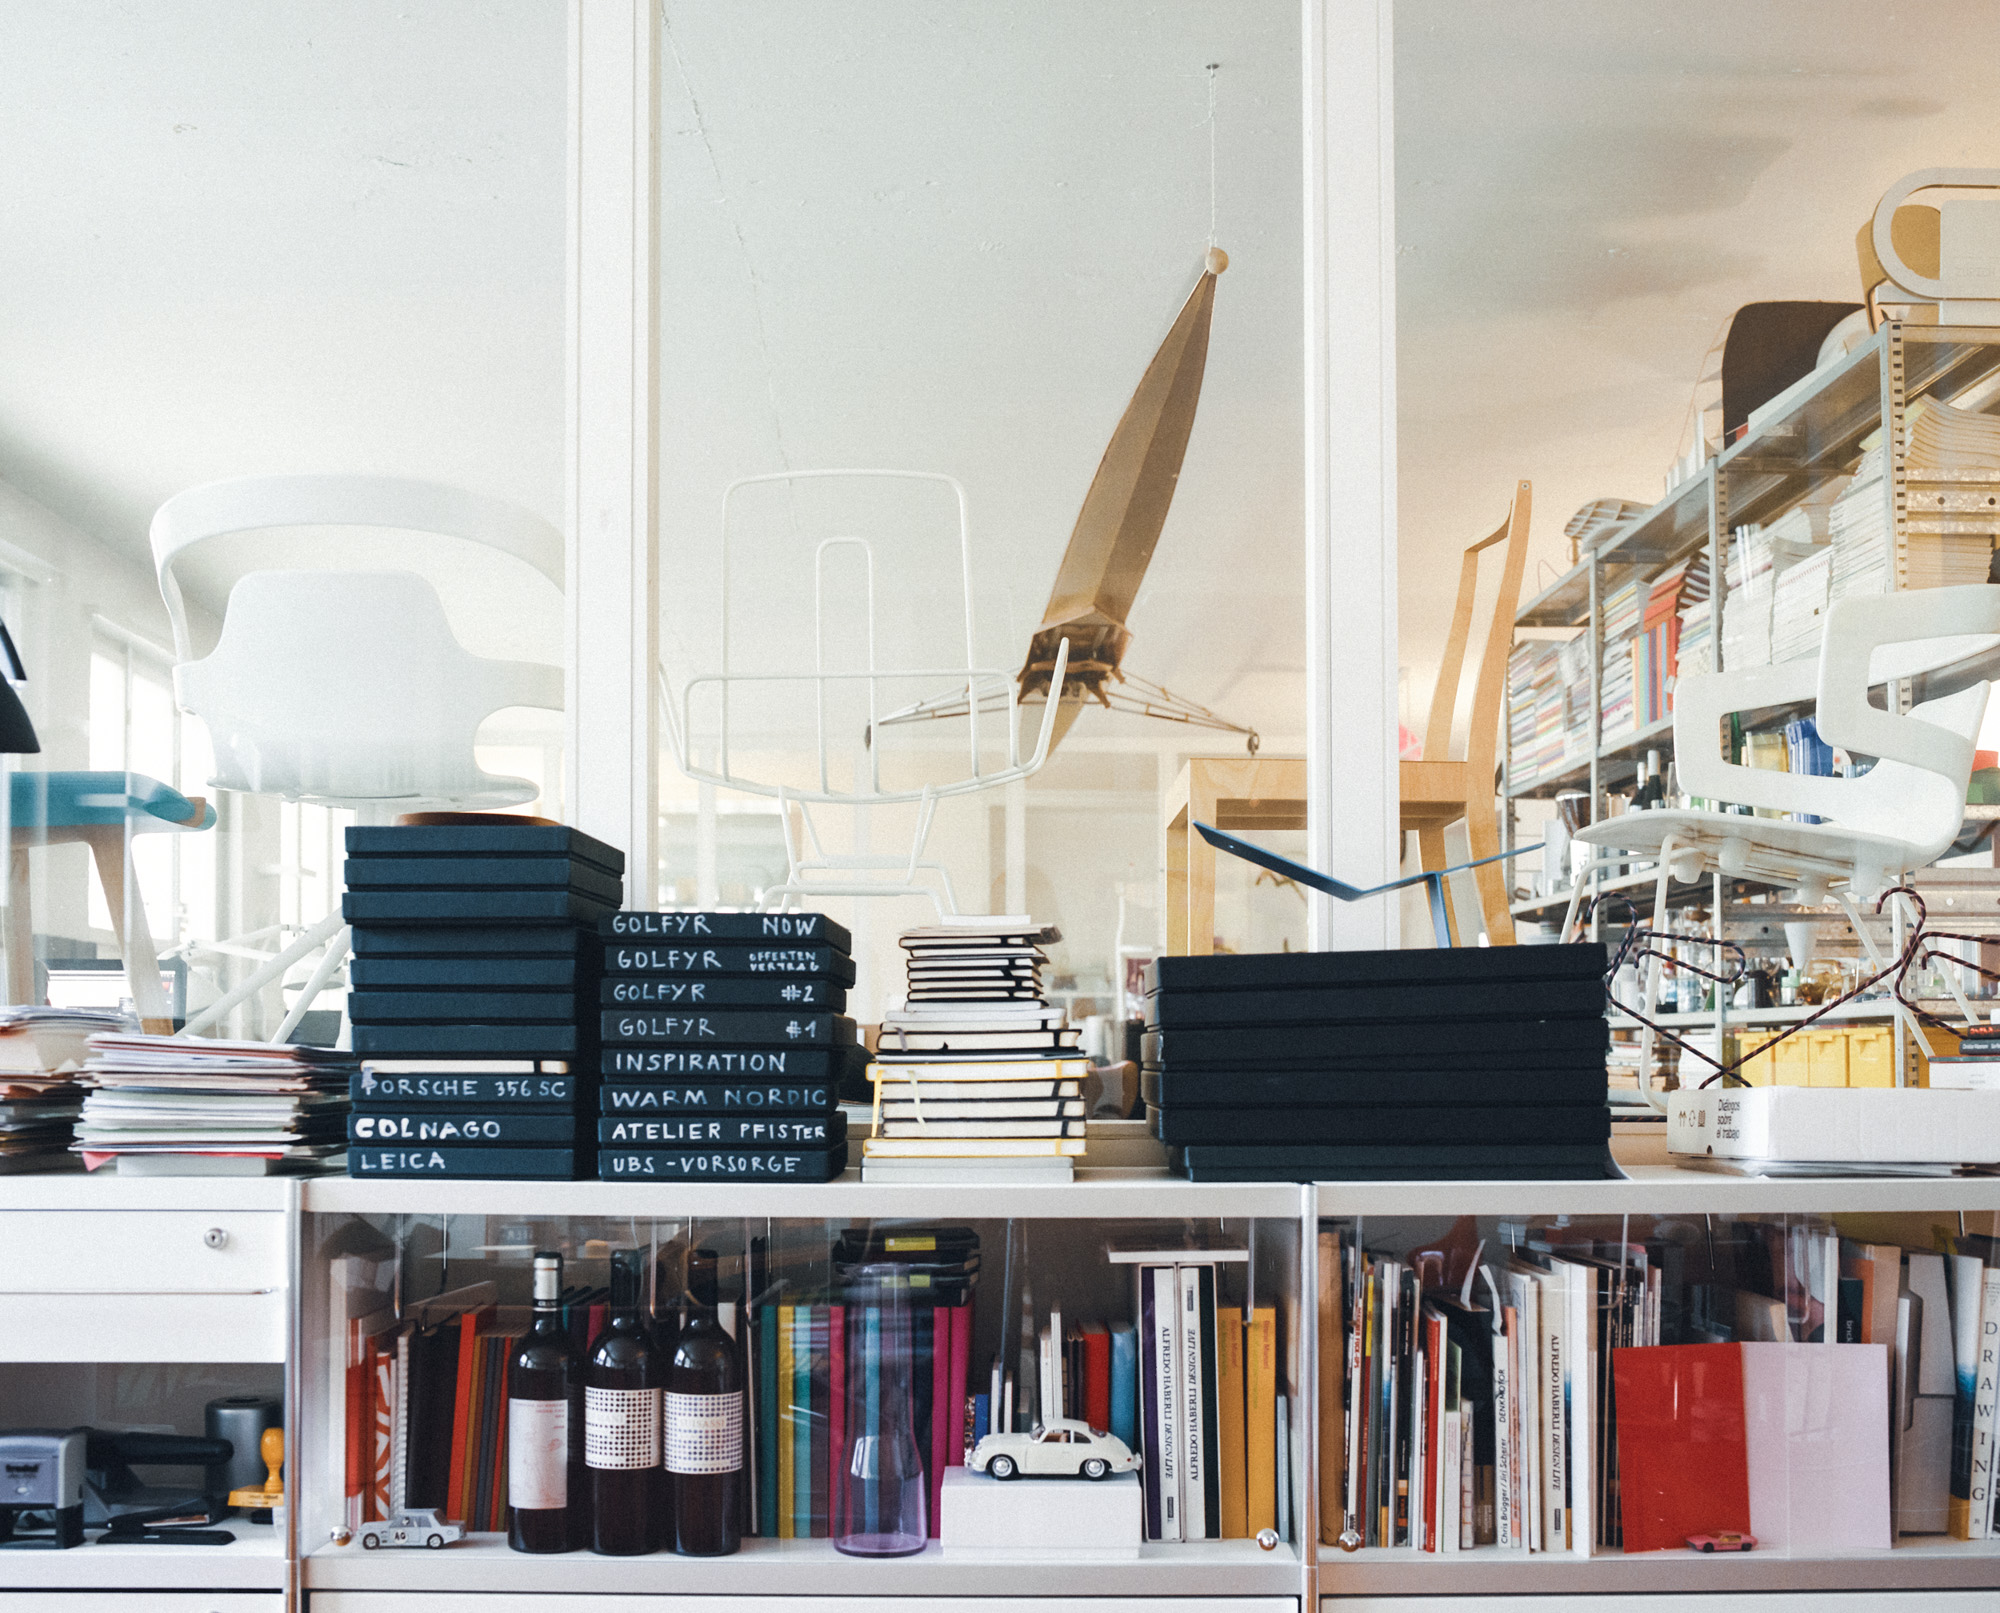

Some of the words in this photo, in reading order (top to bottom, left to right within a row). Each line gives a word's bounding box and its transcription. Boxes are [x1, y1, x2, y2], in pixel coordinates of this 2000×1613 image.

[612, 915, 712, 934] GOLFYR
[762, 916, 817, 936] NOW
[617, 950, 722, 969] GOLFYR
[613, 983, 706, 1001] GOLFYR
[781, 985, 815, 1002] #2
[619, 1017, 716, 1036] GOLFYR
[785, 1020, 817, 1039] #1
[616, 1052, 786, 1072] INSPIRATION
[361, 1079, 478, 1096] PORSCHE
[494, 1080, 532, 1097] 356
[538, 1080, 566, 1097] SC
[612, 1090, 708, 1107] WARM
[724, 1088, 826, 1106] NORDIC
[355, 1117, 501, 1140] COLNAGO
[611, 1123, 721, 1140] ATELIER
[739, 1123, 826, 1141] PFISTER
[360, 1151, 446, 1170] LEICA
[612, 1156, 655, 1173] UBS
[1162, 1326, 1173, 1374] ALFREDO
[1187, 1328, 1196, 1350] LIVE
[1188, 1351, 1196, 1385] DESIGN
[1551, 1334, 1560, 1383] ALFREDO
[1163, 1375, 1174, 1420] HÄBERLI
[1498, 1369, 1506, 1423] DENKMOTOR
[1551, 1384, 1562, 1430] HÄBERLI
[1972, 1320, 1998, 1501] DRAWING
[1163, 1422, 1174, 1457] DESIGN
[1552, 1432, 1561, 1469] DESIGN
[1190, 1434, 1199, 1481] ALFREDO
[1499, 1438, 1507, 1468] Scherer
[1164, 1458, 1174, 1479] LIVE
[1552, 1470, 1561, 1491] LIVE
[1500, 1489, 1509, 1521] Brügger
[1500, 1523, 1508, 1544] Chris
